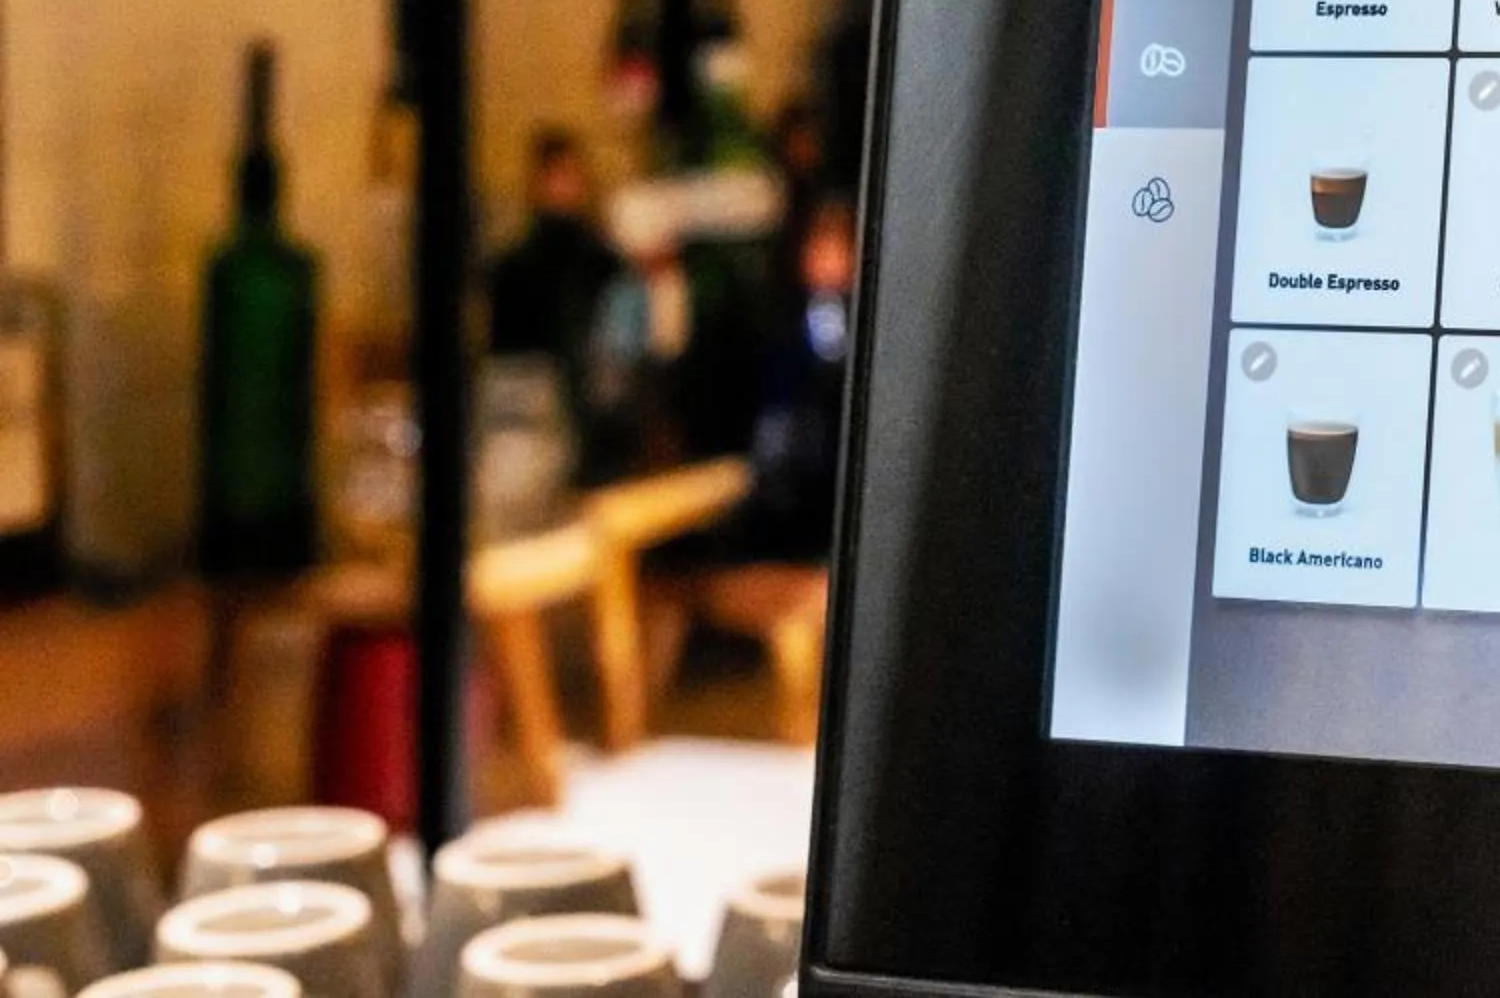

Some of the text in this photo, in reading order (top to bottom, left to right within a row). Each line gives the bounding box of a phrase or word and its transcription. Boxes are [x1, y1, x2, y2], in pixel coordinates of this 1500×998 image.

[1316, 0, 1388, 20] Espresso
[1268, 273, 1400, 294] Double Espresso
[1249, 547, 1383, 569] Black Americano
